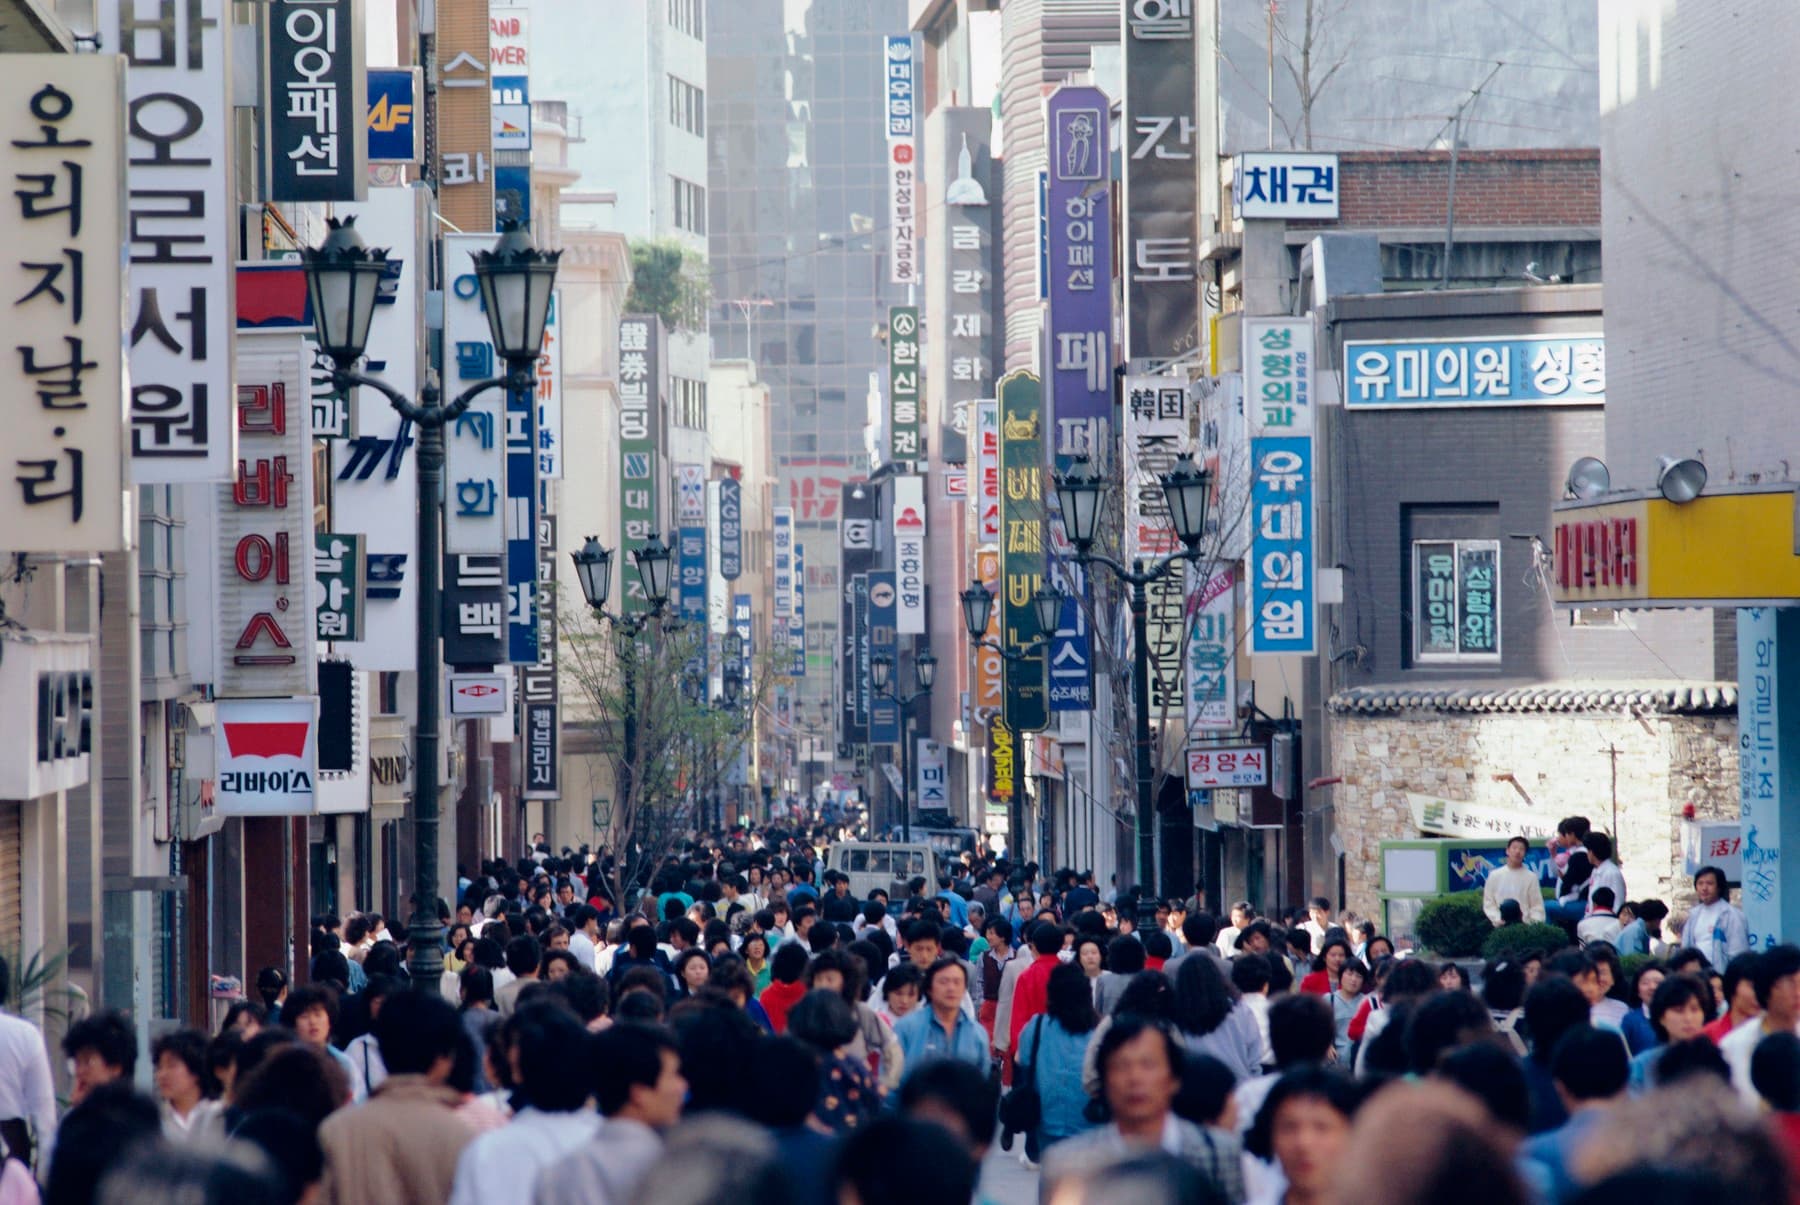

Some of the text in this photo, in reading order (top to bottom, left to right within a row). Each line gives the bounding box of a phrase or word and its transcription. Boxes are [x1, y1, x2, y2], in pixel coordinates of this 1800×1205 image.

[1245, 165, 1334, 205] 채권
[952, 225, 984, 382] 금강제화
[893, 340, 917, 453] 한신증권
[1355, 345, 1511, 400] 유미의원
[1260, 450, 1304, 641] 유미의원
[1191, 752, 1262, 774] 경양식
